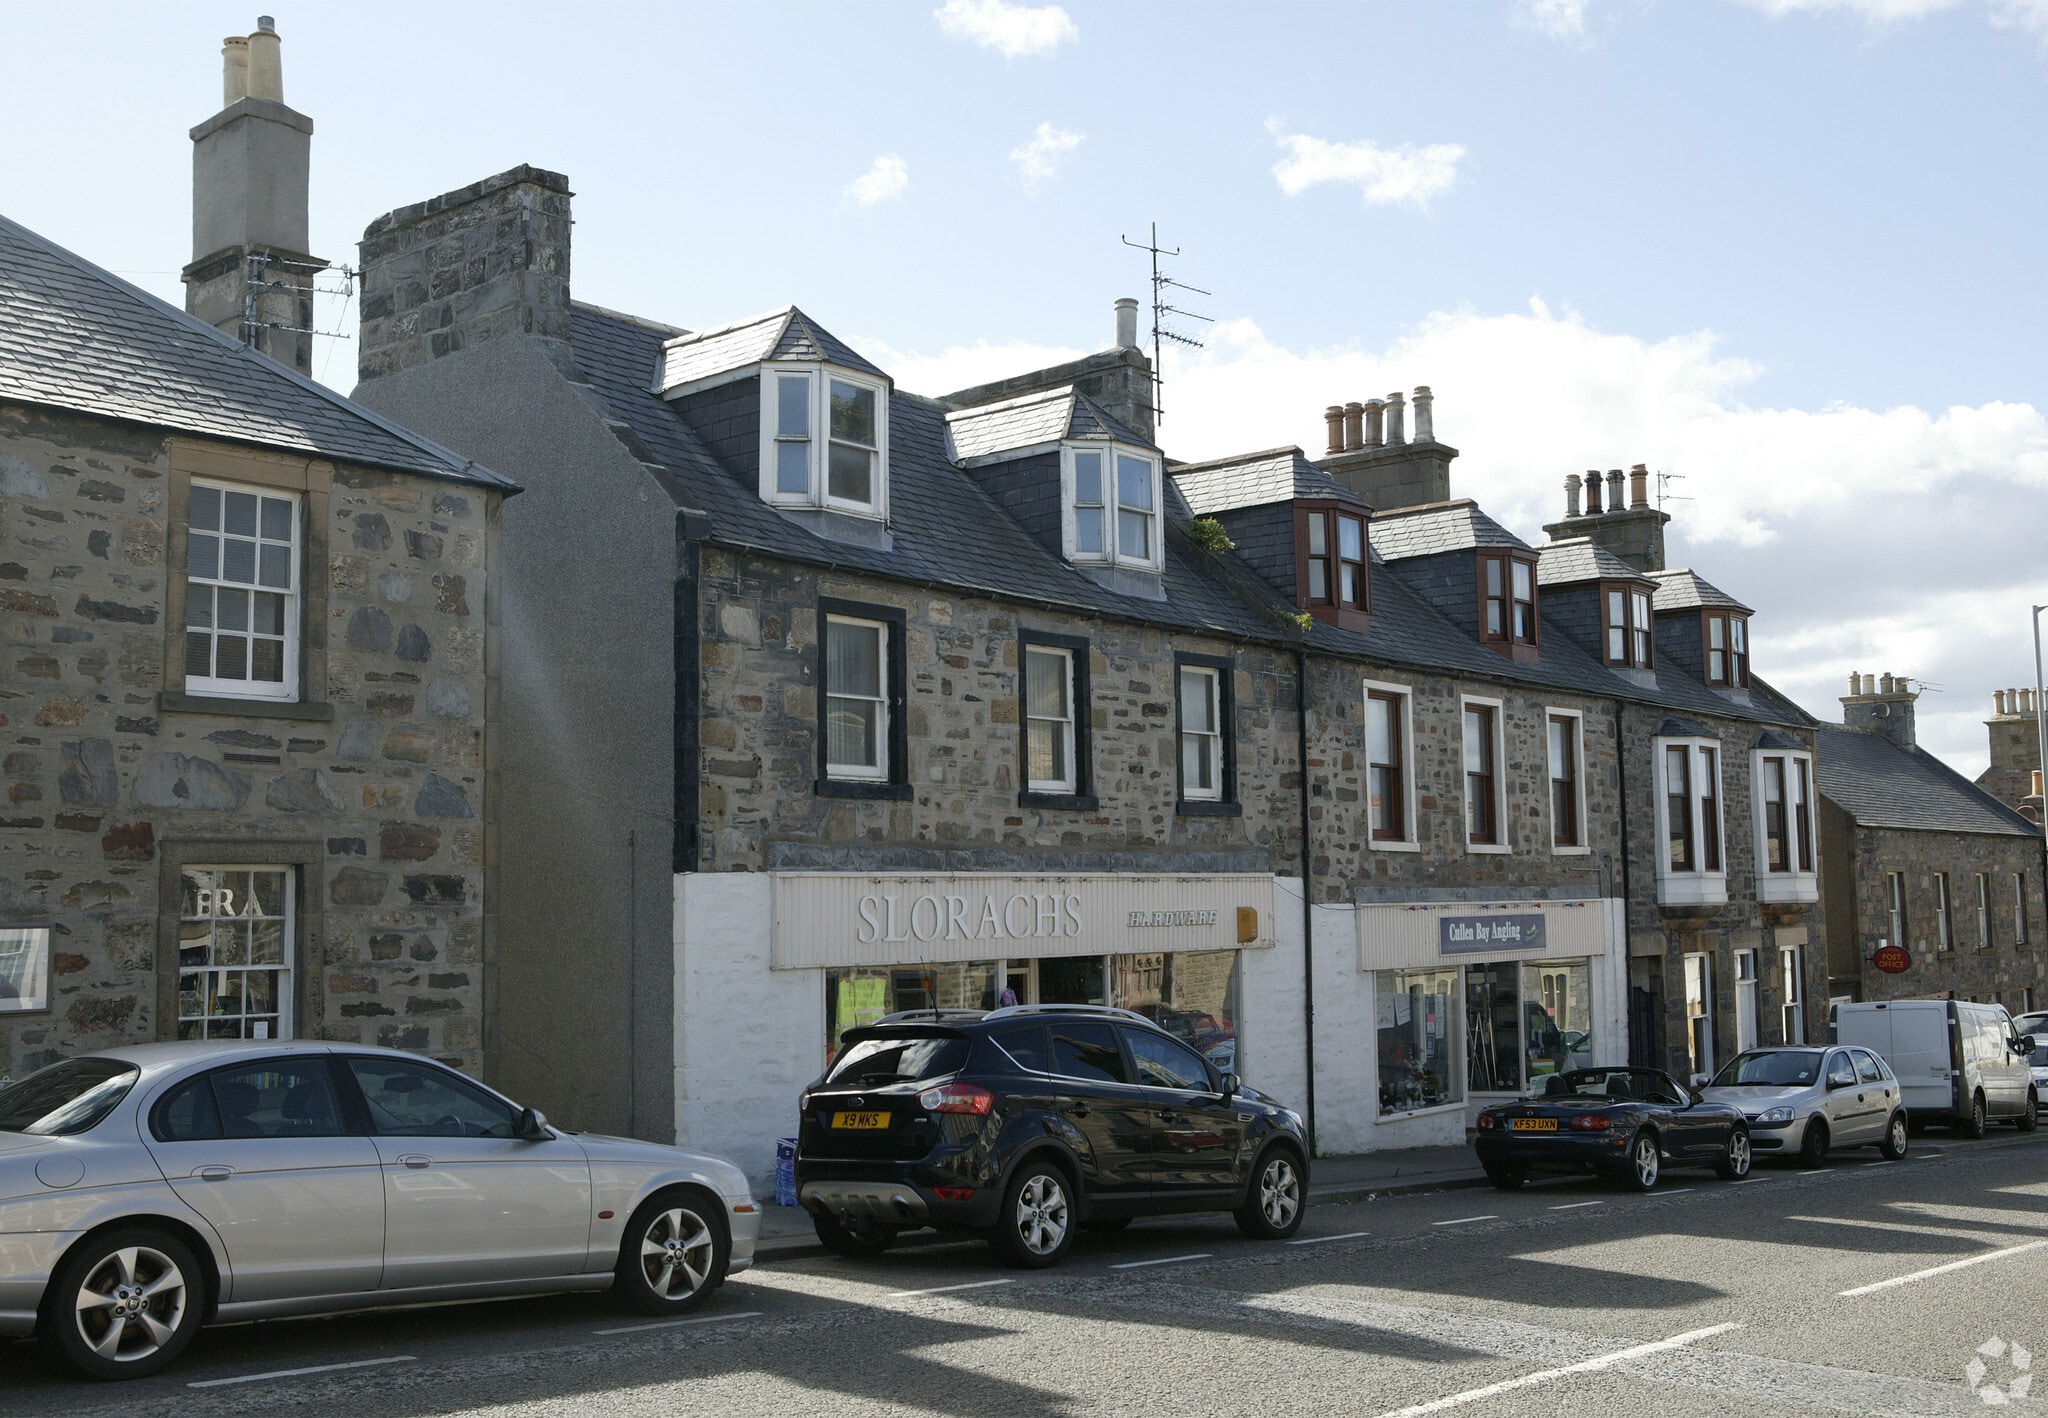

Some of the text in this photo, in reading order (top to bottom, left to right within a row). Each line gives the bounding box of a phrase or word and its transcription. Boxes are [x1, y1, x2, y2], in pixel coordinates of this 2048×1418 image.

[857, 894, 1083, 943] SLORACHS
[1128, 909, 1218, 928] HARDWARE
[1449, 921, 1521, 943] Cullen Bay Angling
[1882, 953, 1902, 961] POST
[1878, 960, 1905, 969] OFFICE
[842, 1113, 880, 1126] X9 MKS
[1513, 1119, 1556, 1129] KF53 UXN
